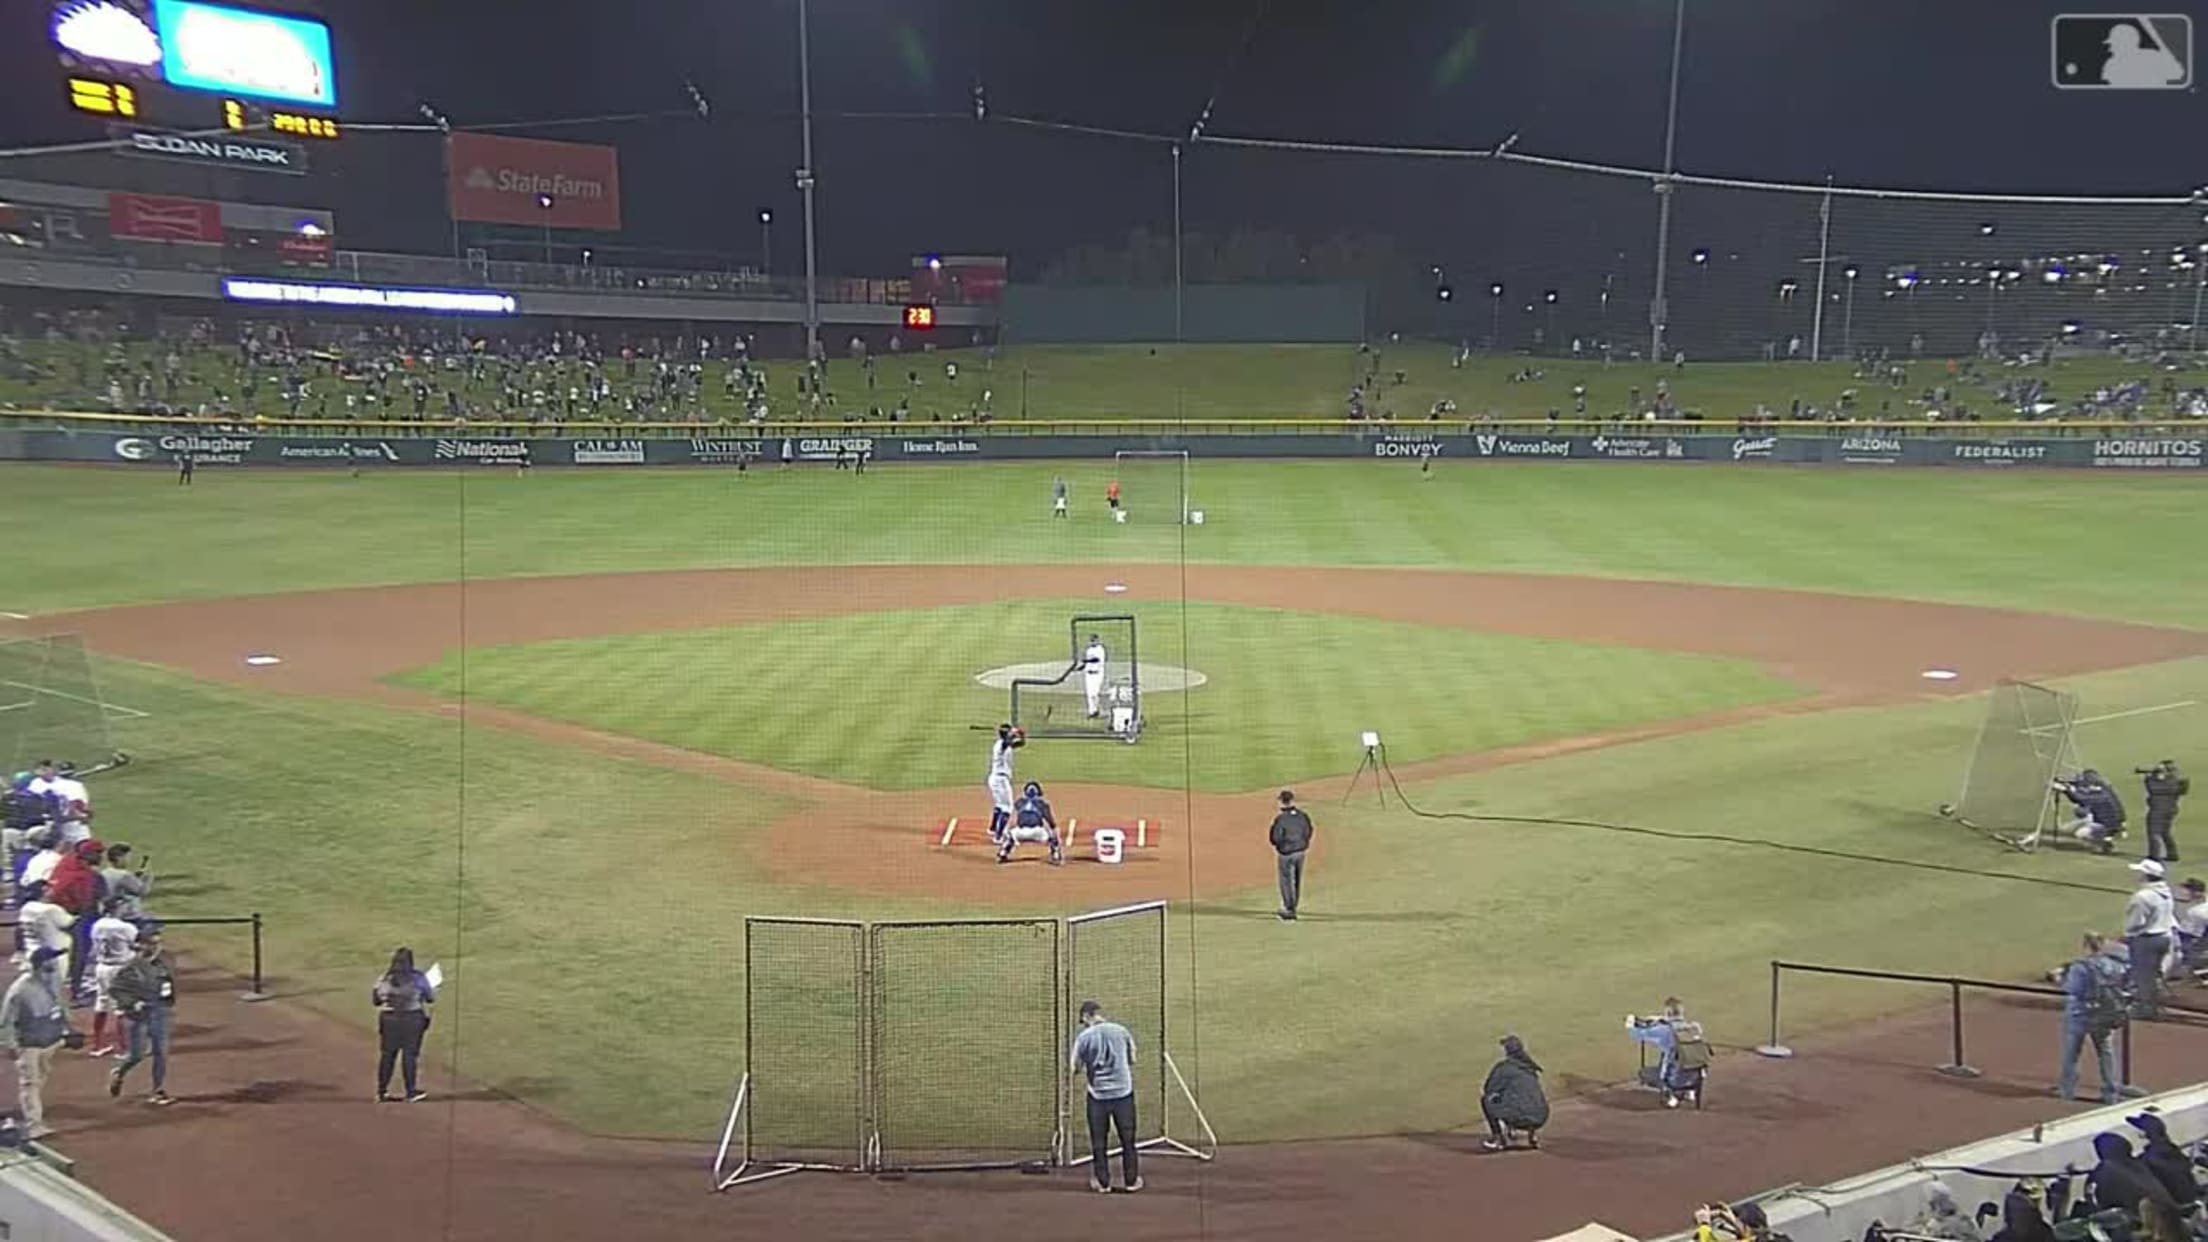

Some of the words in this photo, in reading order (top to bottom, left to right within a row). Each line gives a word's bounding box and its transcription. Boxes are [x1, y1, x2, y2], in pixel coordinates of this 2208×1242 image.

[223, 144, 290, 165] PARK
[160, 435, 253, 453] Gallagher
[1499, 440, 1540, 453] Vienna
[1841, 438, 1901, 451] ARIZONA
[2094, 440, 2201, 456] HORNITOS
[1955, 446, 2046, 458] FEDERALIST
